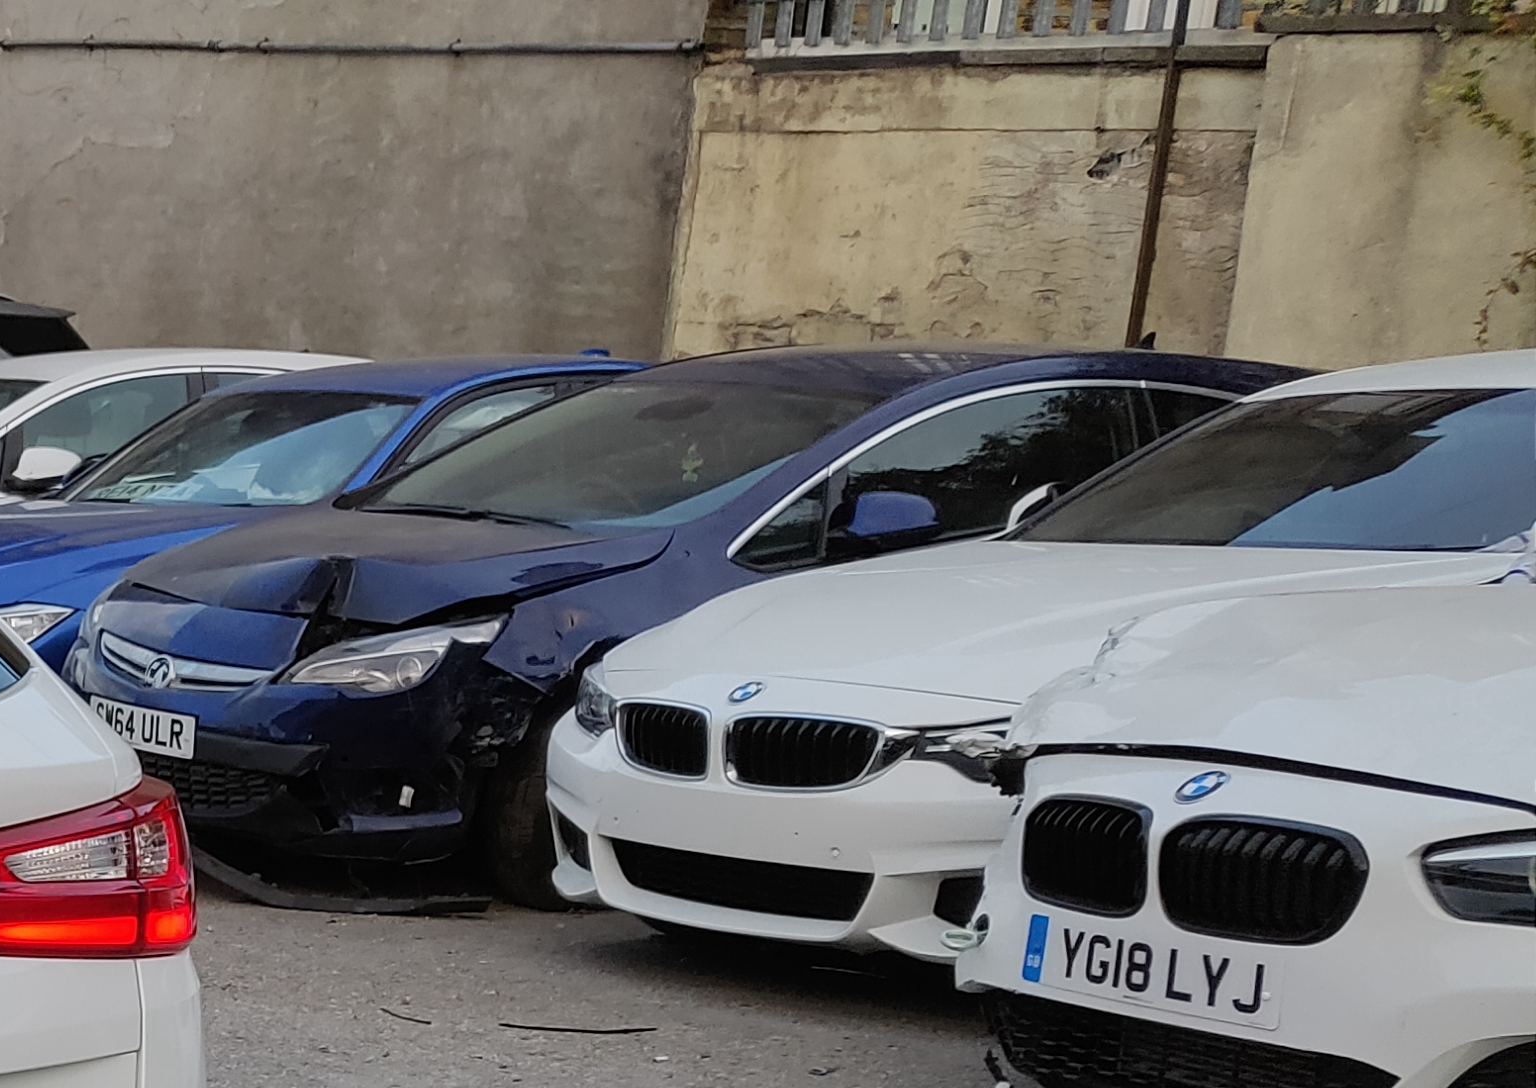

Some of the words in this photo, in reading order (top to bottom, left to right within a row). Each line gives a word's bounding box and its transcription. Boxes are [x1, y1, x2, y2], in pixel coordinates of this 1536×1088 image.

[141, 712, 185, 750] ULR
[1063, 928, 1154, 993] YG18
[1164, 948, 1266, 1015] LYJ
